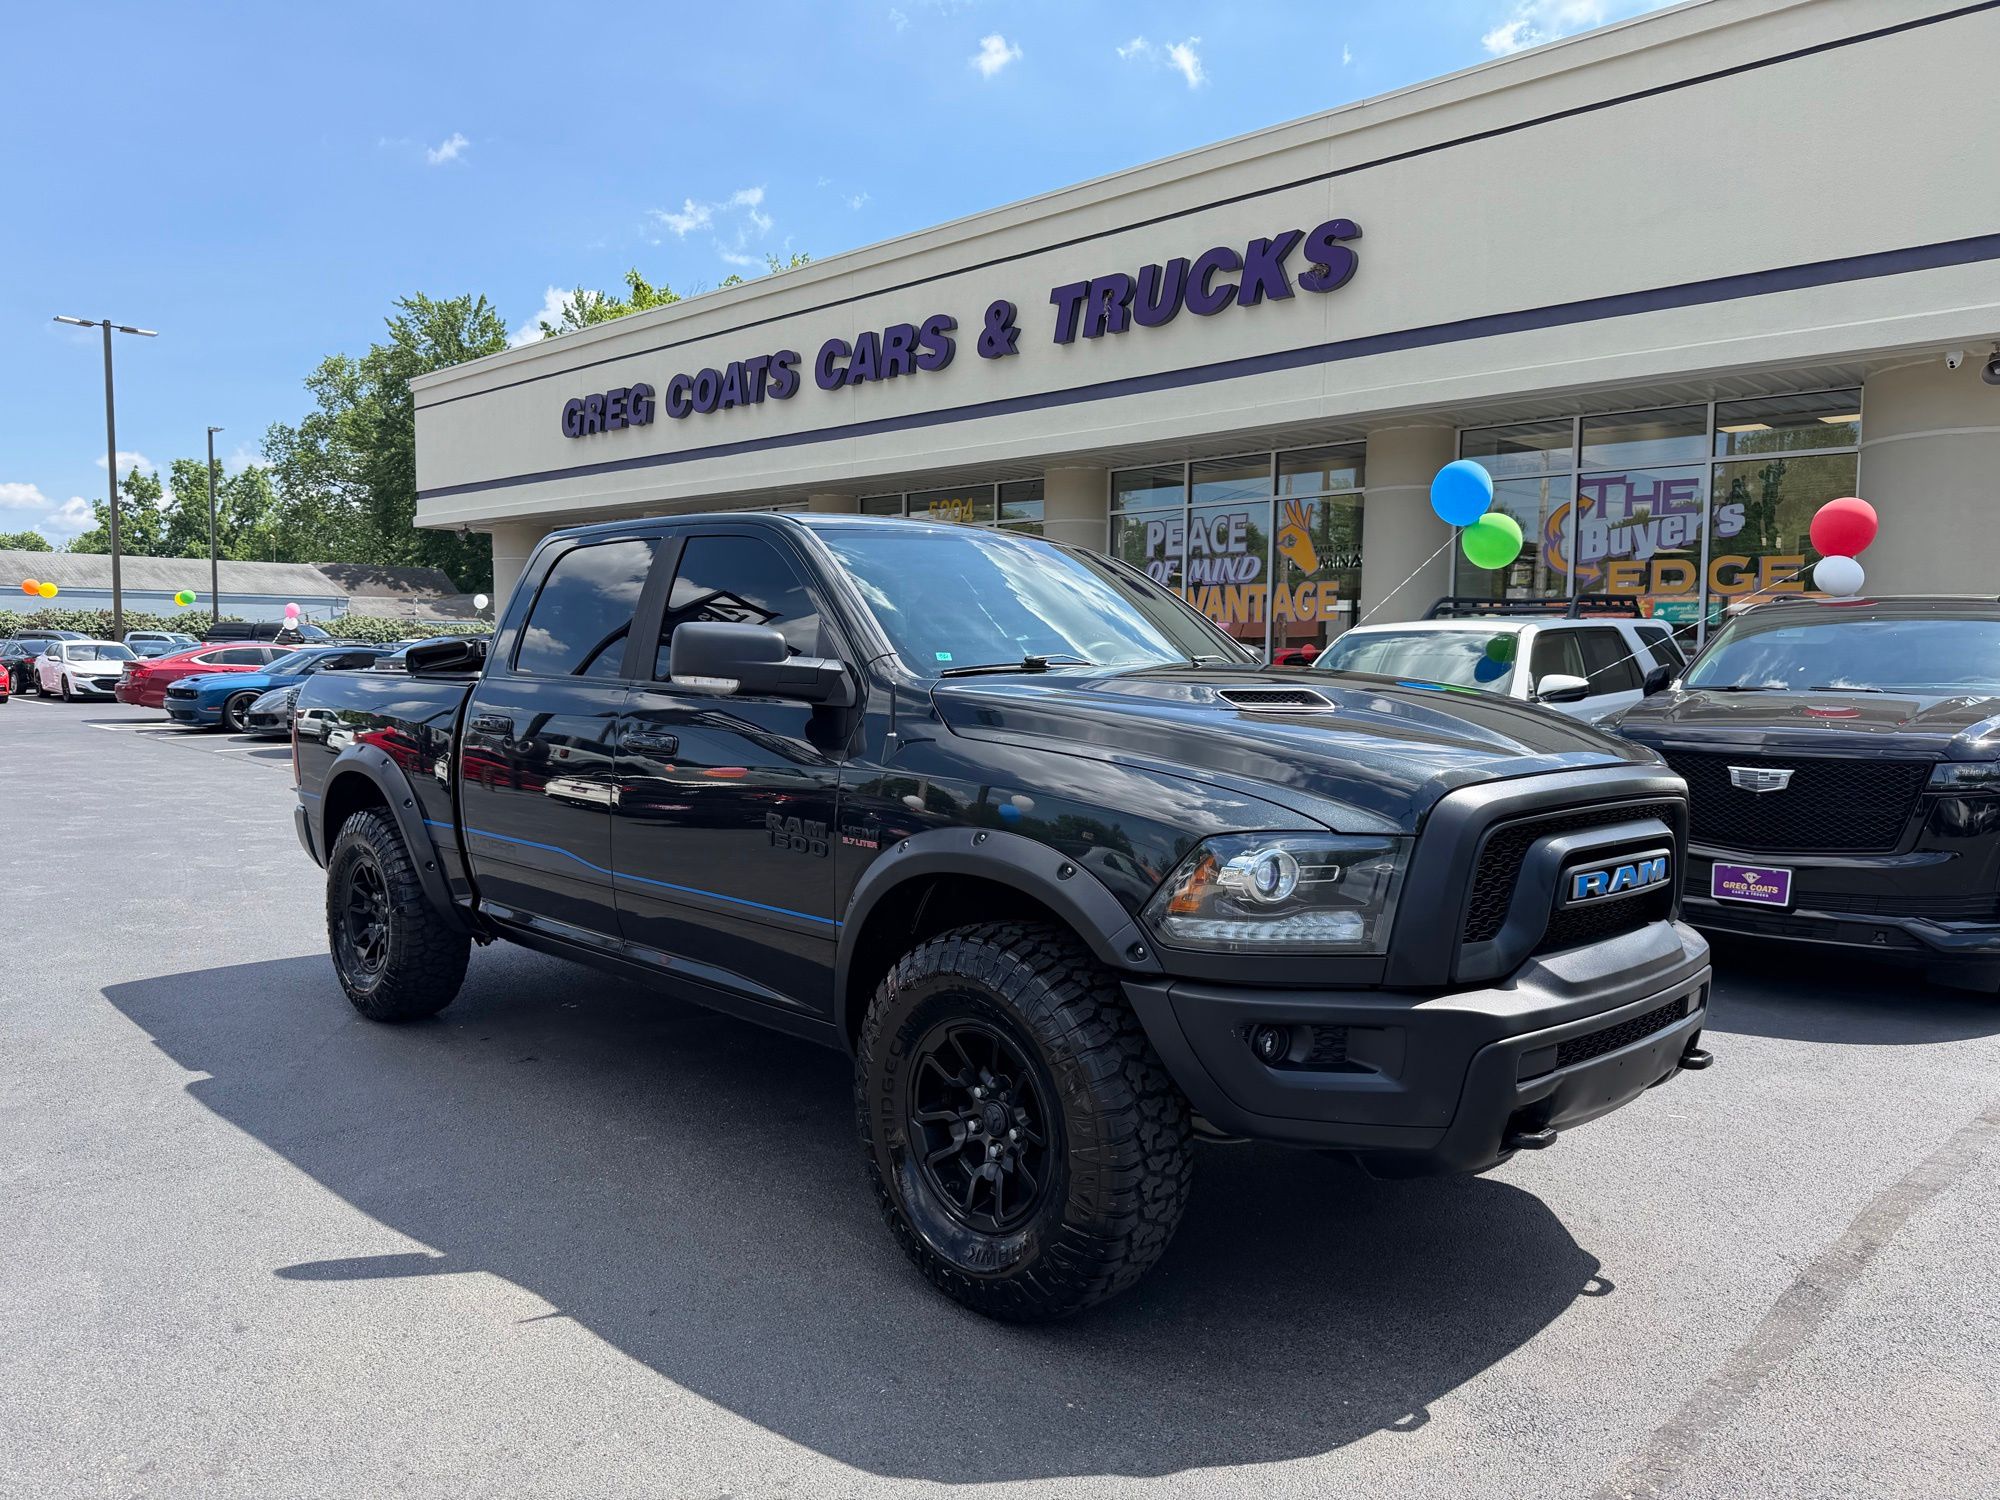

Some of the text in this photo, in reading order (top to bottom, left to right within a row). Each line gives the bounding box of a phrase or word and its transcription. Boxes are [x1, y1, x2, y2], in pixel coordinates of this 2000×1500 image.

[562, 218, 1362, 438] GREG COATS CARS & TRUCKS
[1580, 474, 1700, 519] THE
[1146, 513, 1249, 558] PEACE
[1146, 556, 1262, 587] OF MIND
[1607, 554, 1806, 595] EDGE
[1168, 580, 1340, 623] VANTAGE
[766, 812, 828, 839] RAM
[766, 830, 828, 858] 1500
[1573, 857, 1666, 899] RAM
[1722, 881, 1779, 894] GREG COATS
